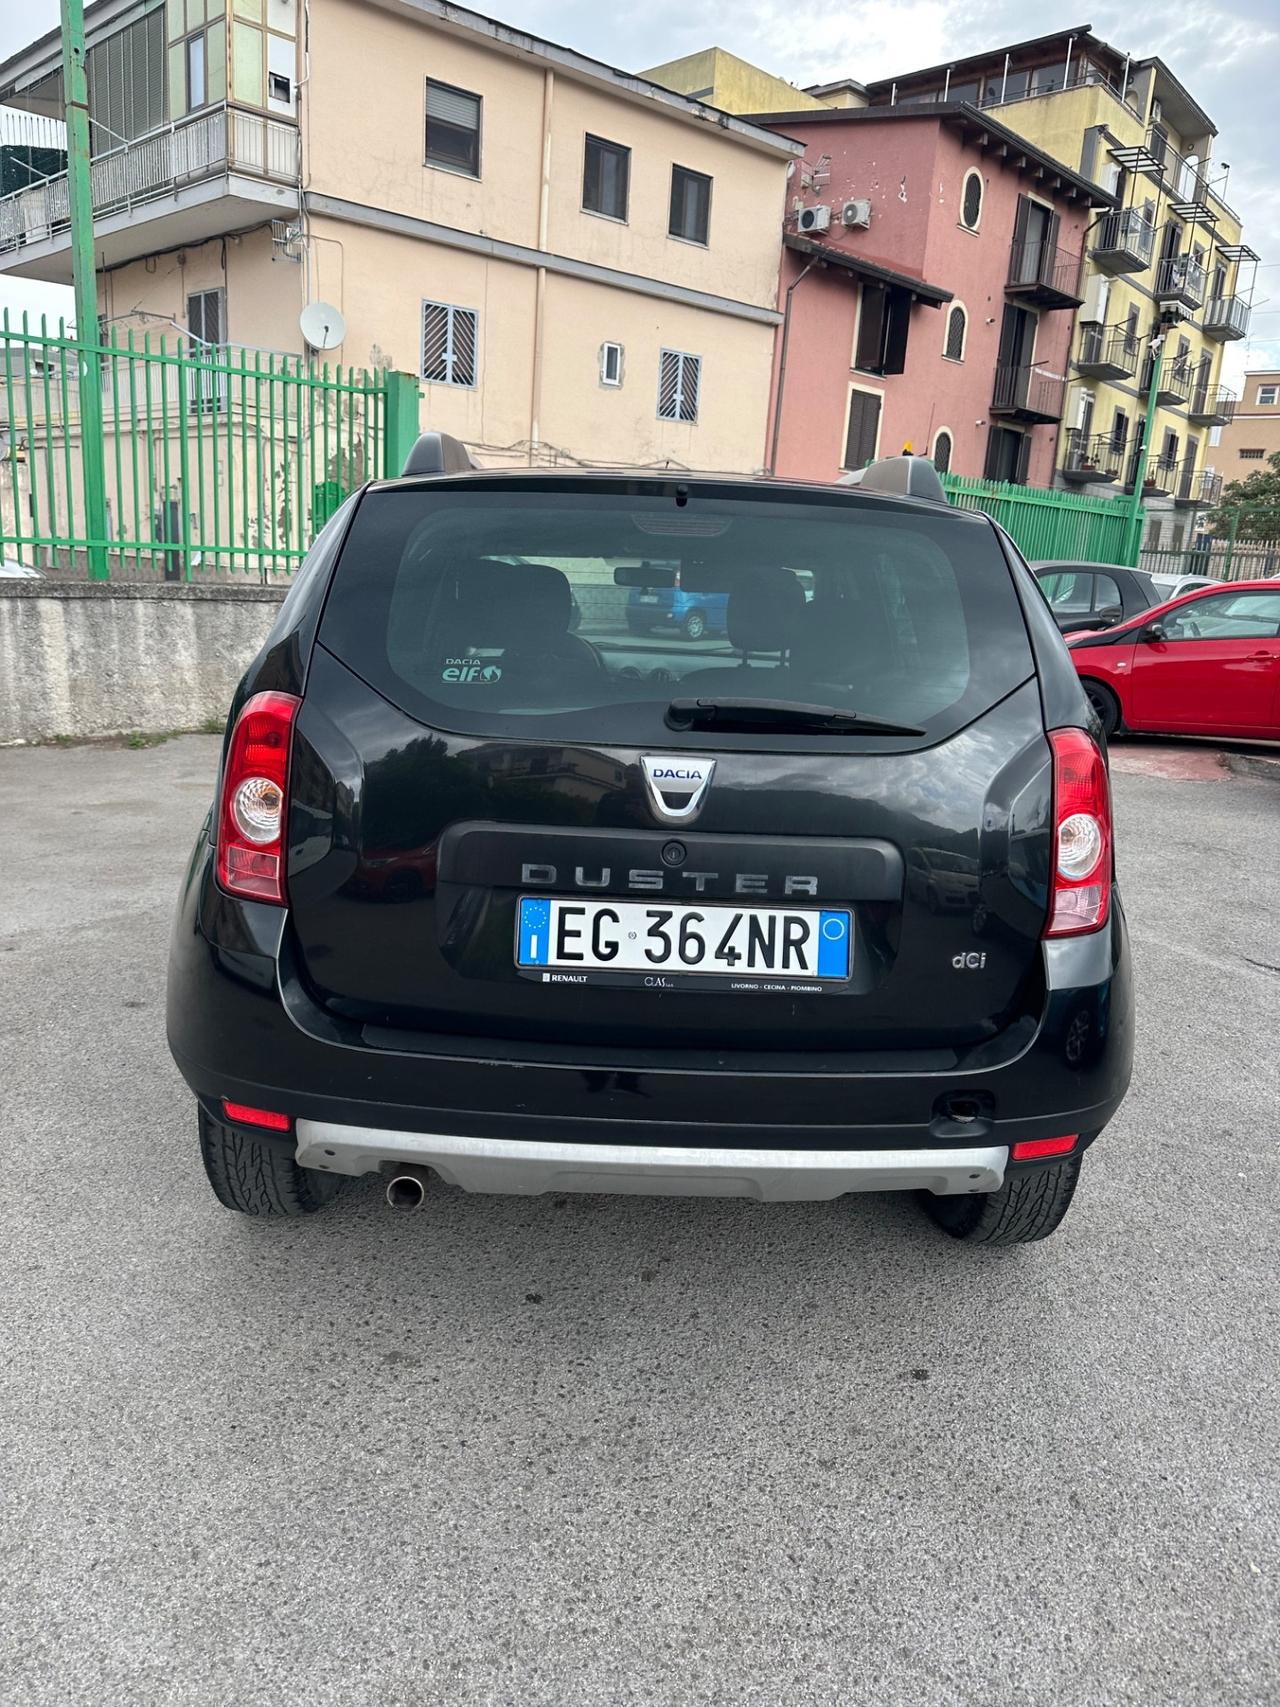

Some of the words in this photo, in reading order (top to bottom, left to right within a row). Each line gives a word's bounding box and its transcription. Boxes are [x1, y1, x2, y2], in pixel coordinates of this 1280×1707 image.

[442, 666, 481, 682] elf
[652, 768, 703, 780] DACIA
[520, 863, 819, 896] DUSTER
[556, 906, 620, 962] EG
[644, 909, 811, 970] 364NR
[952, 952, 986, 969] dCi
[551, 974, 588, 983] RENAULT
[791, 985, 823, 993] PIOMBINO
